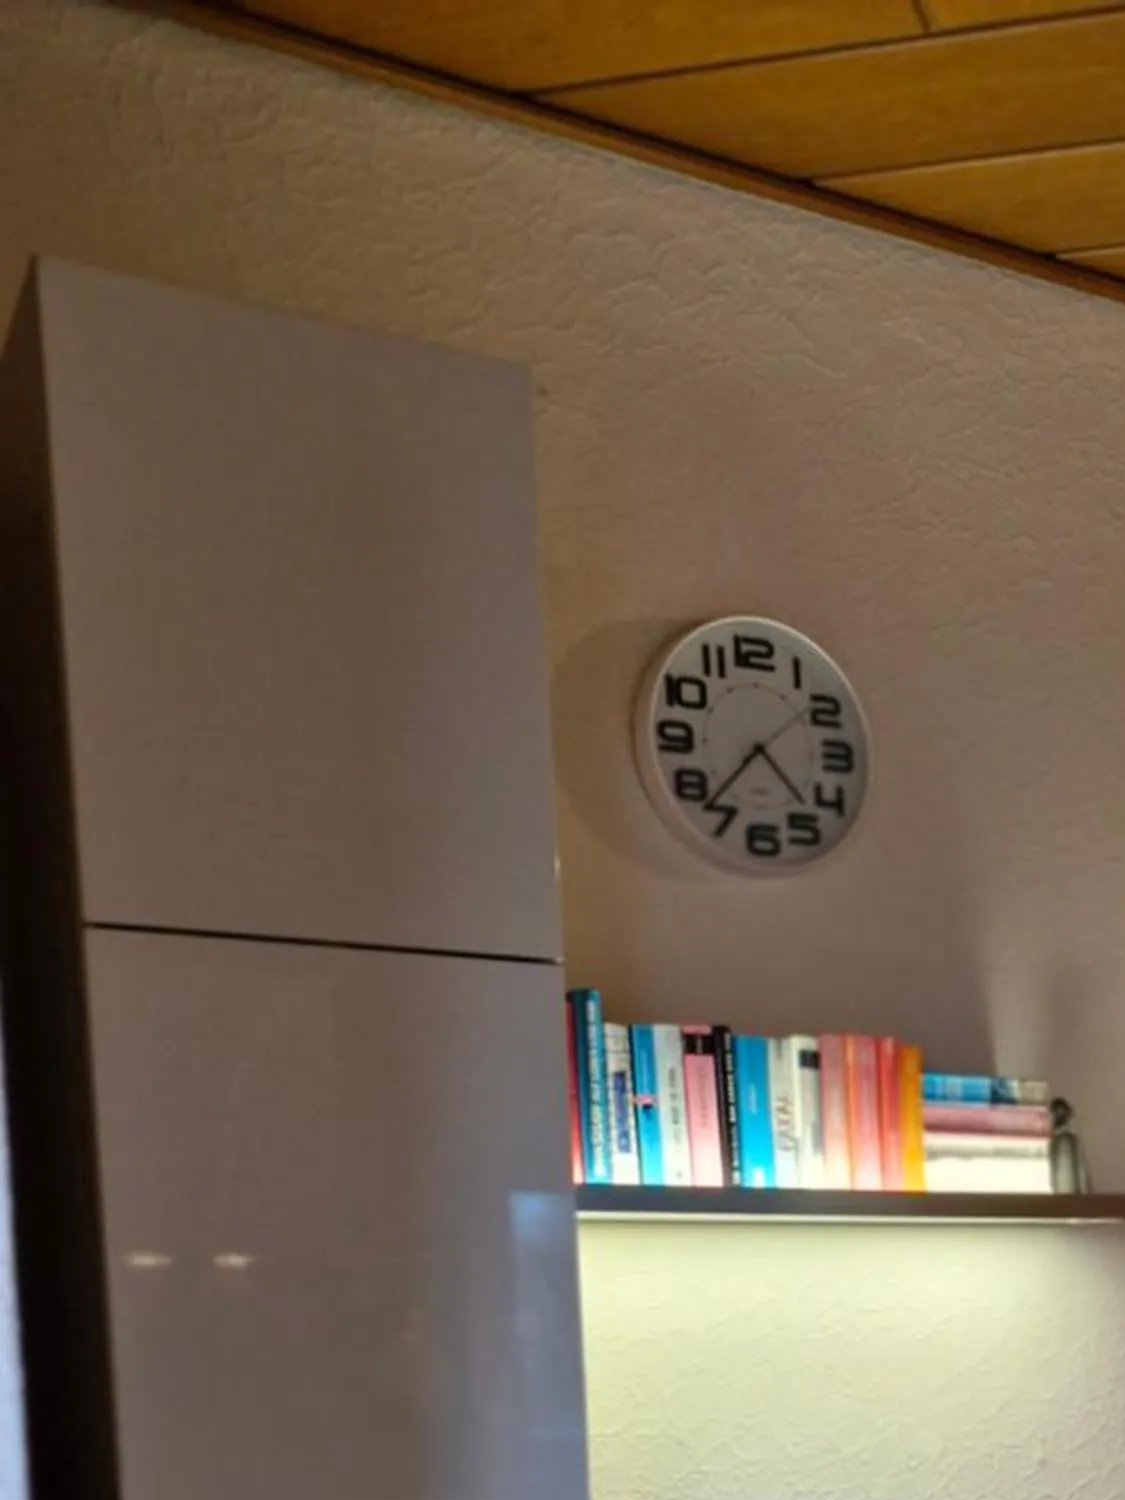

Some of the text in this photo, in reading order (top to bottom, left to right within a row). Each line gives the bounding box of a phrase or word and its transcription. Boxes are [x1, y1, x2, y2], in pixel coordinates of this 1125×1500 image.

[702, 644, 727, 679] 11
[733, 634, 776, 672] 12
[792, 656, 802, 690] 1
[664, 673, 708, 710] 10
[809, 694, 843, 729] 2
[656, 719, 695, 754] 9
[821, 738, 855, 774] 3
[673, 767, 709, 802] 8
[814, 782, 845, 818] 4
[703, 804, 739, 837] 7
[787, 812, 821, 846] 5
[746, 822, 782, 857] 6
